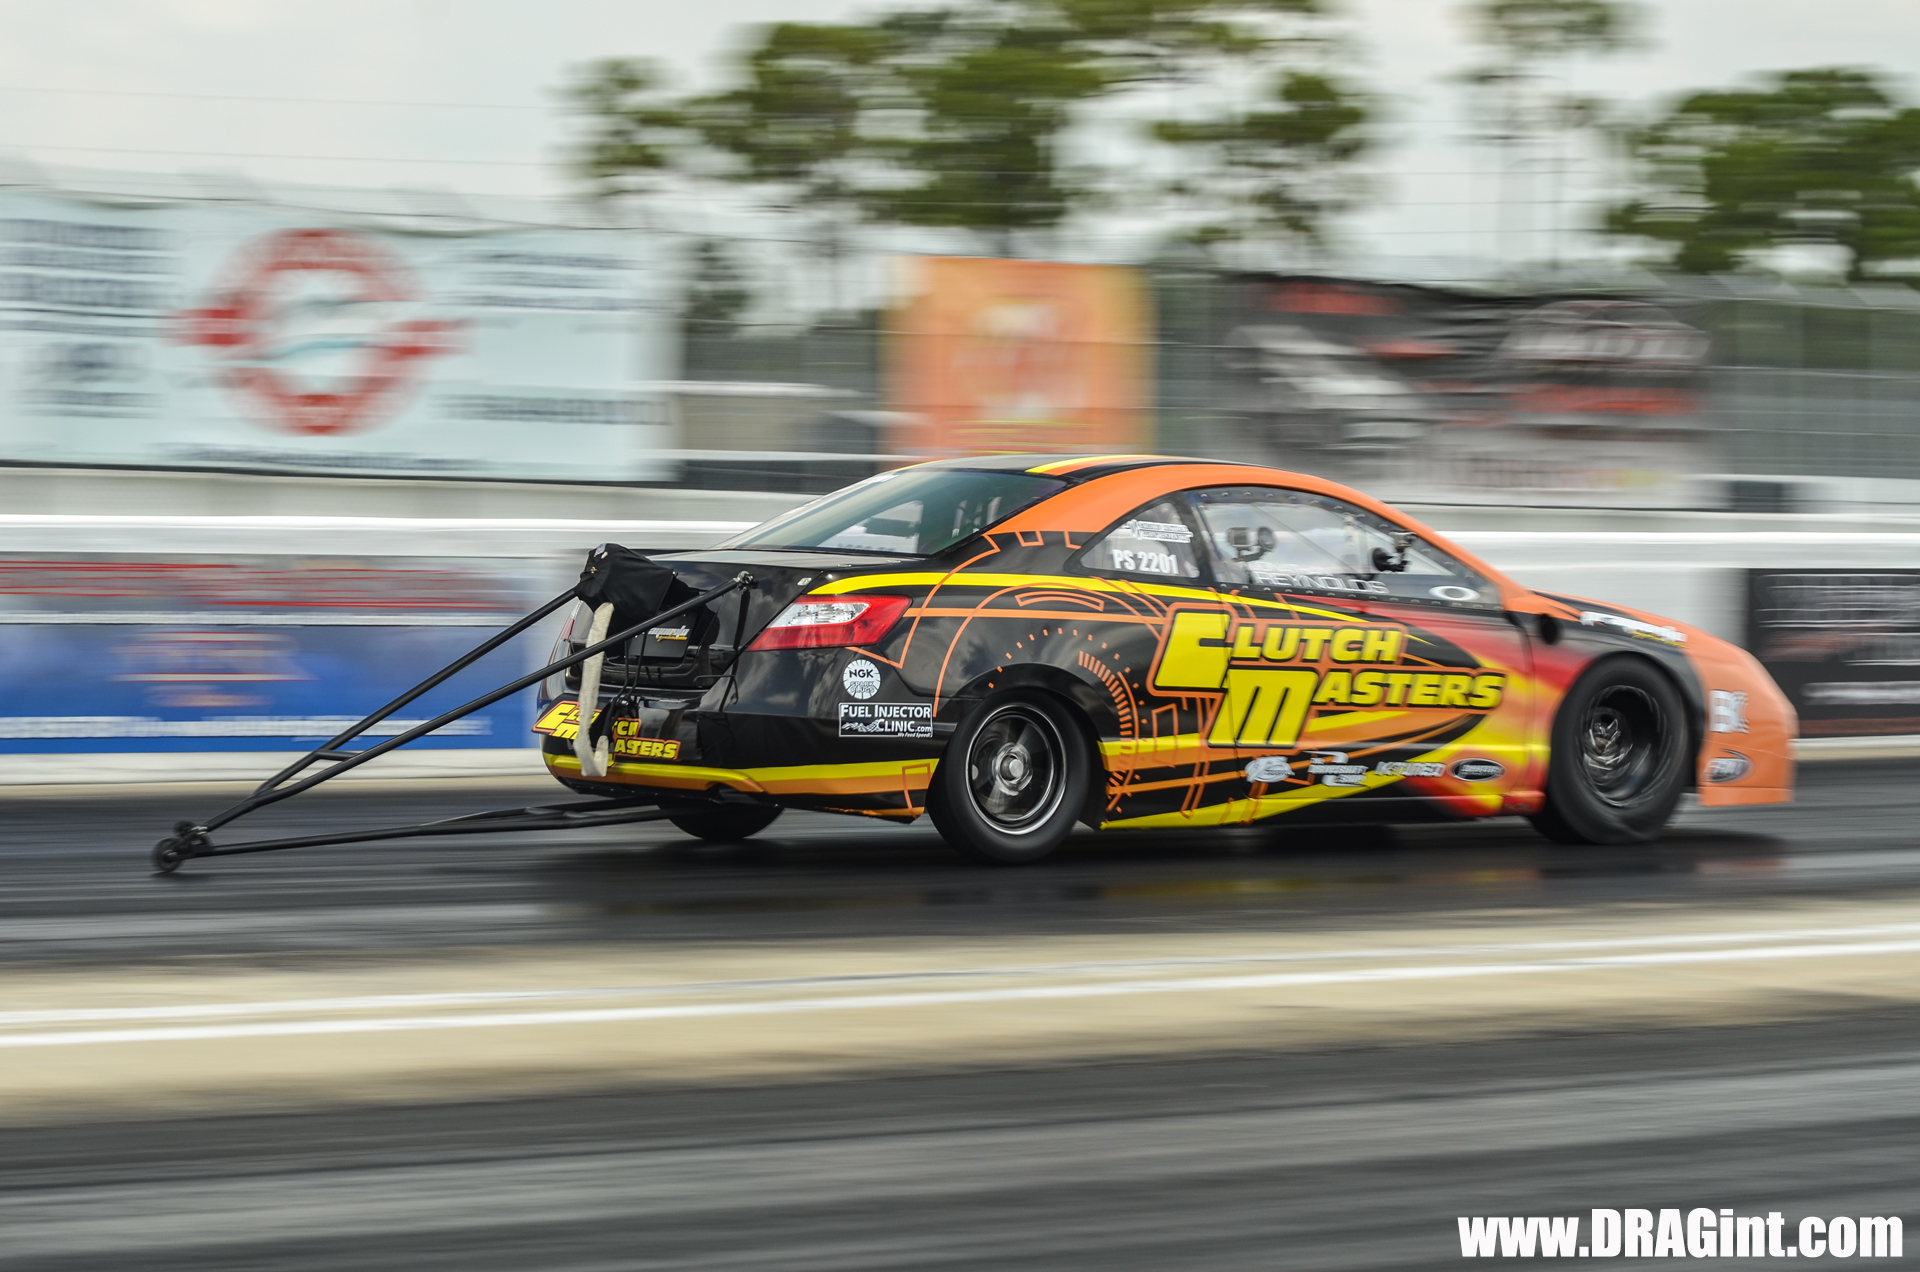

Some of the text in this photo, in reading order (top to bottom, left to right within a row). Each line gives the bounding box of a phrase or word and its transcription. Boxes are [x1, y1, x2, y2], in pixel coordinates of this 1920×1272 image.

[1112, 548, 1179, 574] PS 2201
[1251, 570, 1390, 594] REYNOLDS
[1154, 612, 1403, 688] CLUTCH
[848, 668, 874, 679] NGK
[840, 704, 931, 719] FUEL INJECTOR
[1207, 668, 1506, 747] MASTERS
